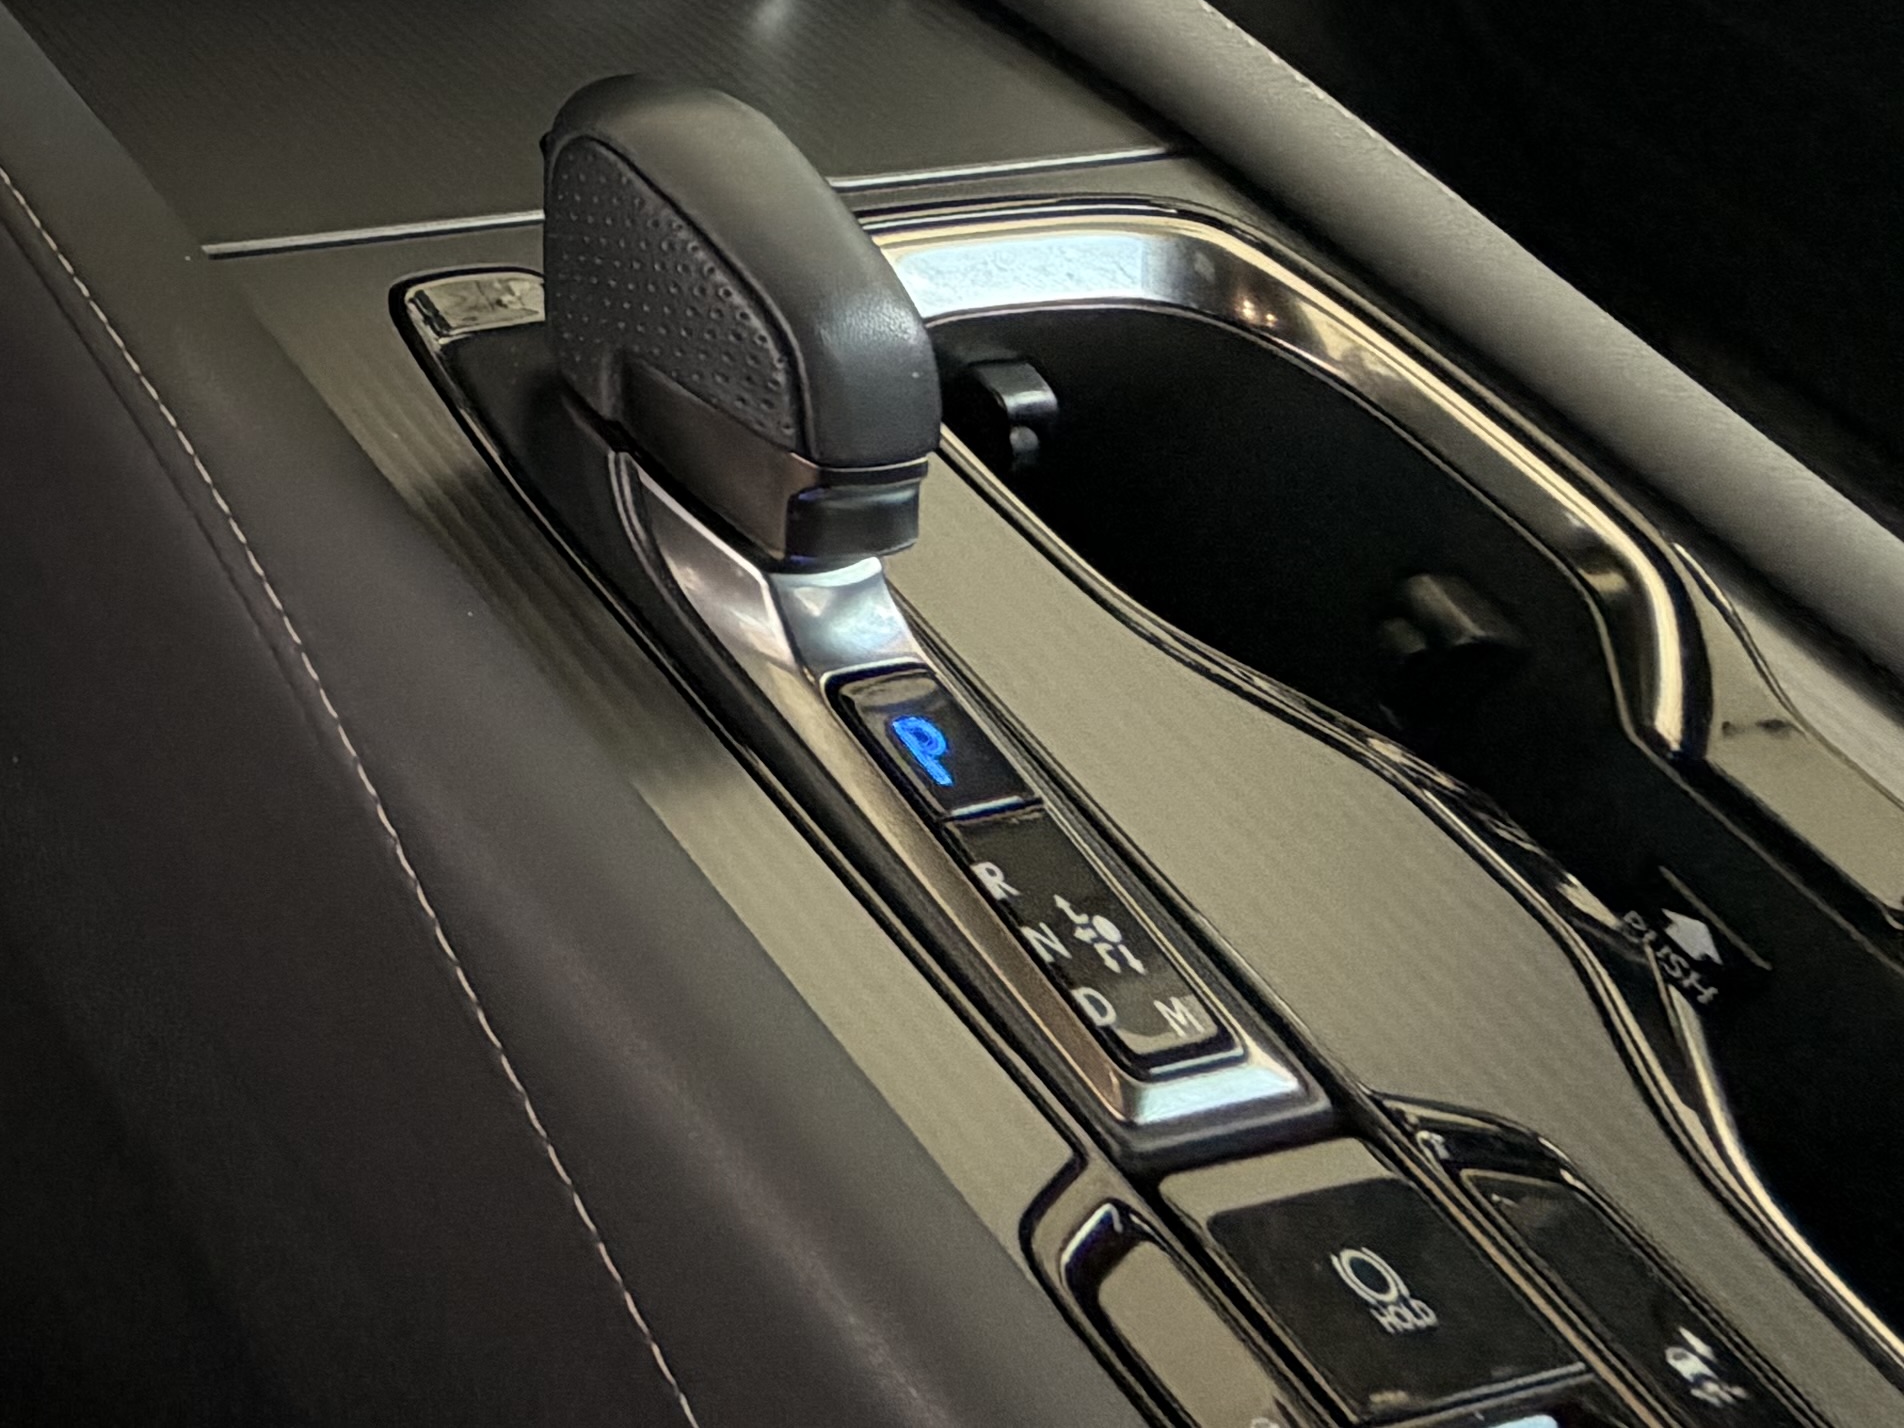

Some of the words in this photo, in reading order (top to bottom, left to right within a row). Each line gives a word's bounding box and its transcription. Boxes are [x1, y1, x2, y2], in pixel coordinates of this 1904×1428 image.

[891, 715, 955, 787] P
[970, 860, 1020, 900] R
[1021, 921, 1072, 963] N
[1071, 986, 1118, 1027] D
[1153, 996, 1205, 1038] M
[1369, 1298, 1439, 1335] HOLD
